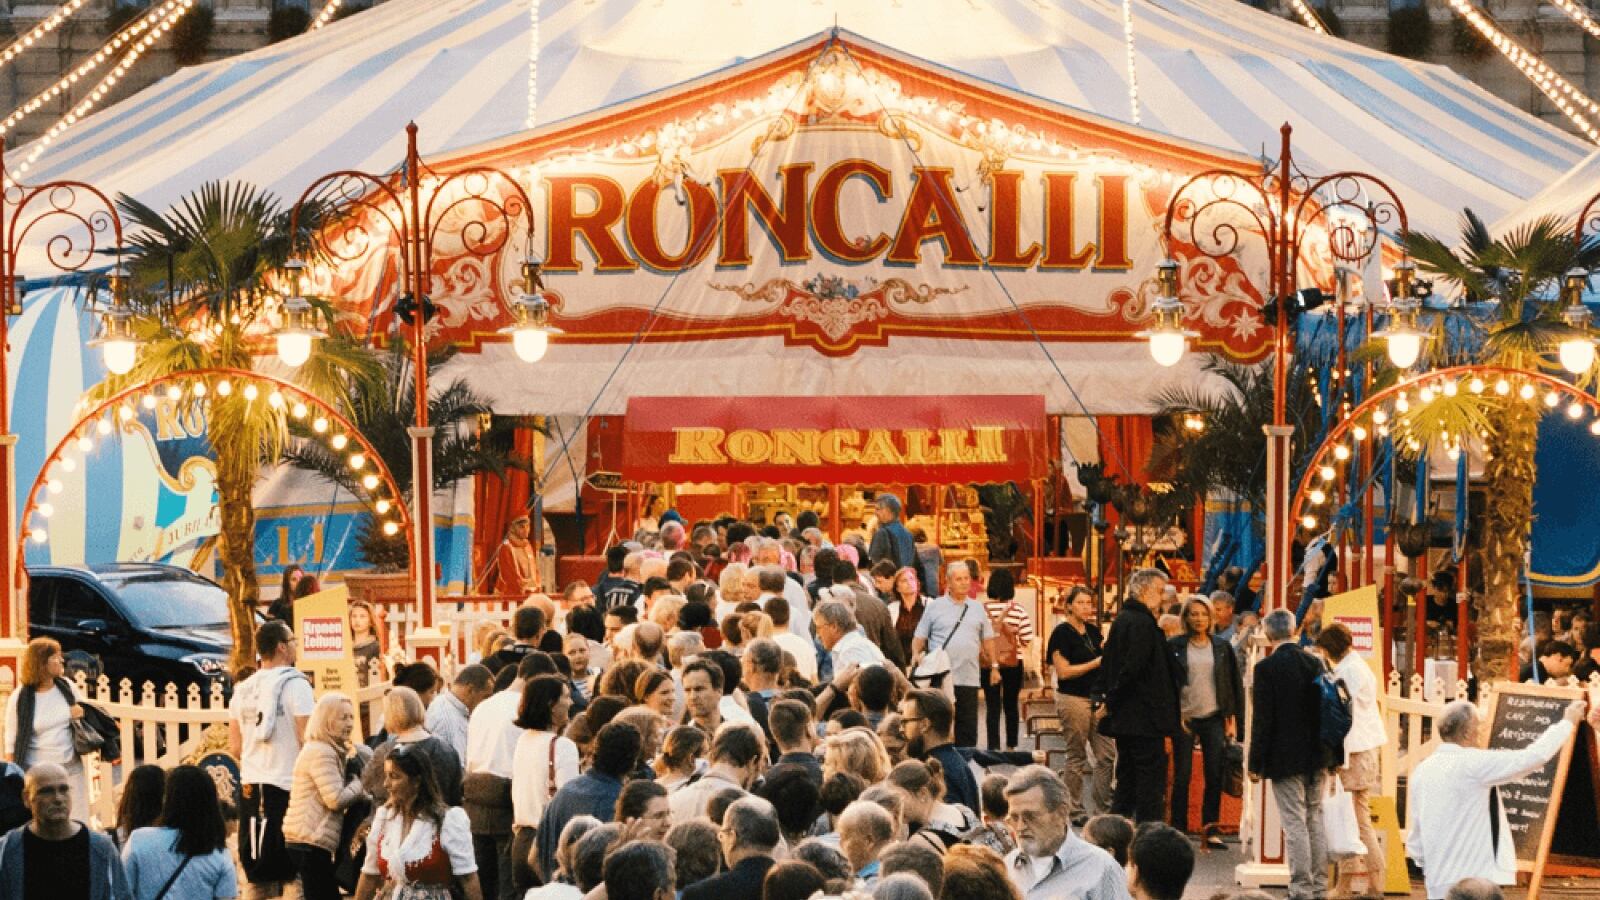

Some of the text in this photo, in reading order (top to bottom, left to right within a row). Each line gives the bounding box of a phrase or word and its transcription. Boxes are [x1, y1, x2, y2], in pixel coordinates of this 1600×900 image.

[541, 158, 1133, 273] RONCALLI
[669, 426, 1008, 466] RONCALLI
[303, 621, 342, 635] Kronen
[303, 634, 342, 650] Zeitung
